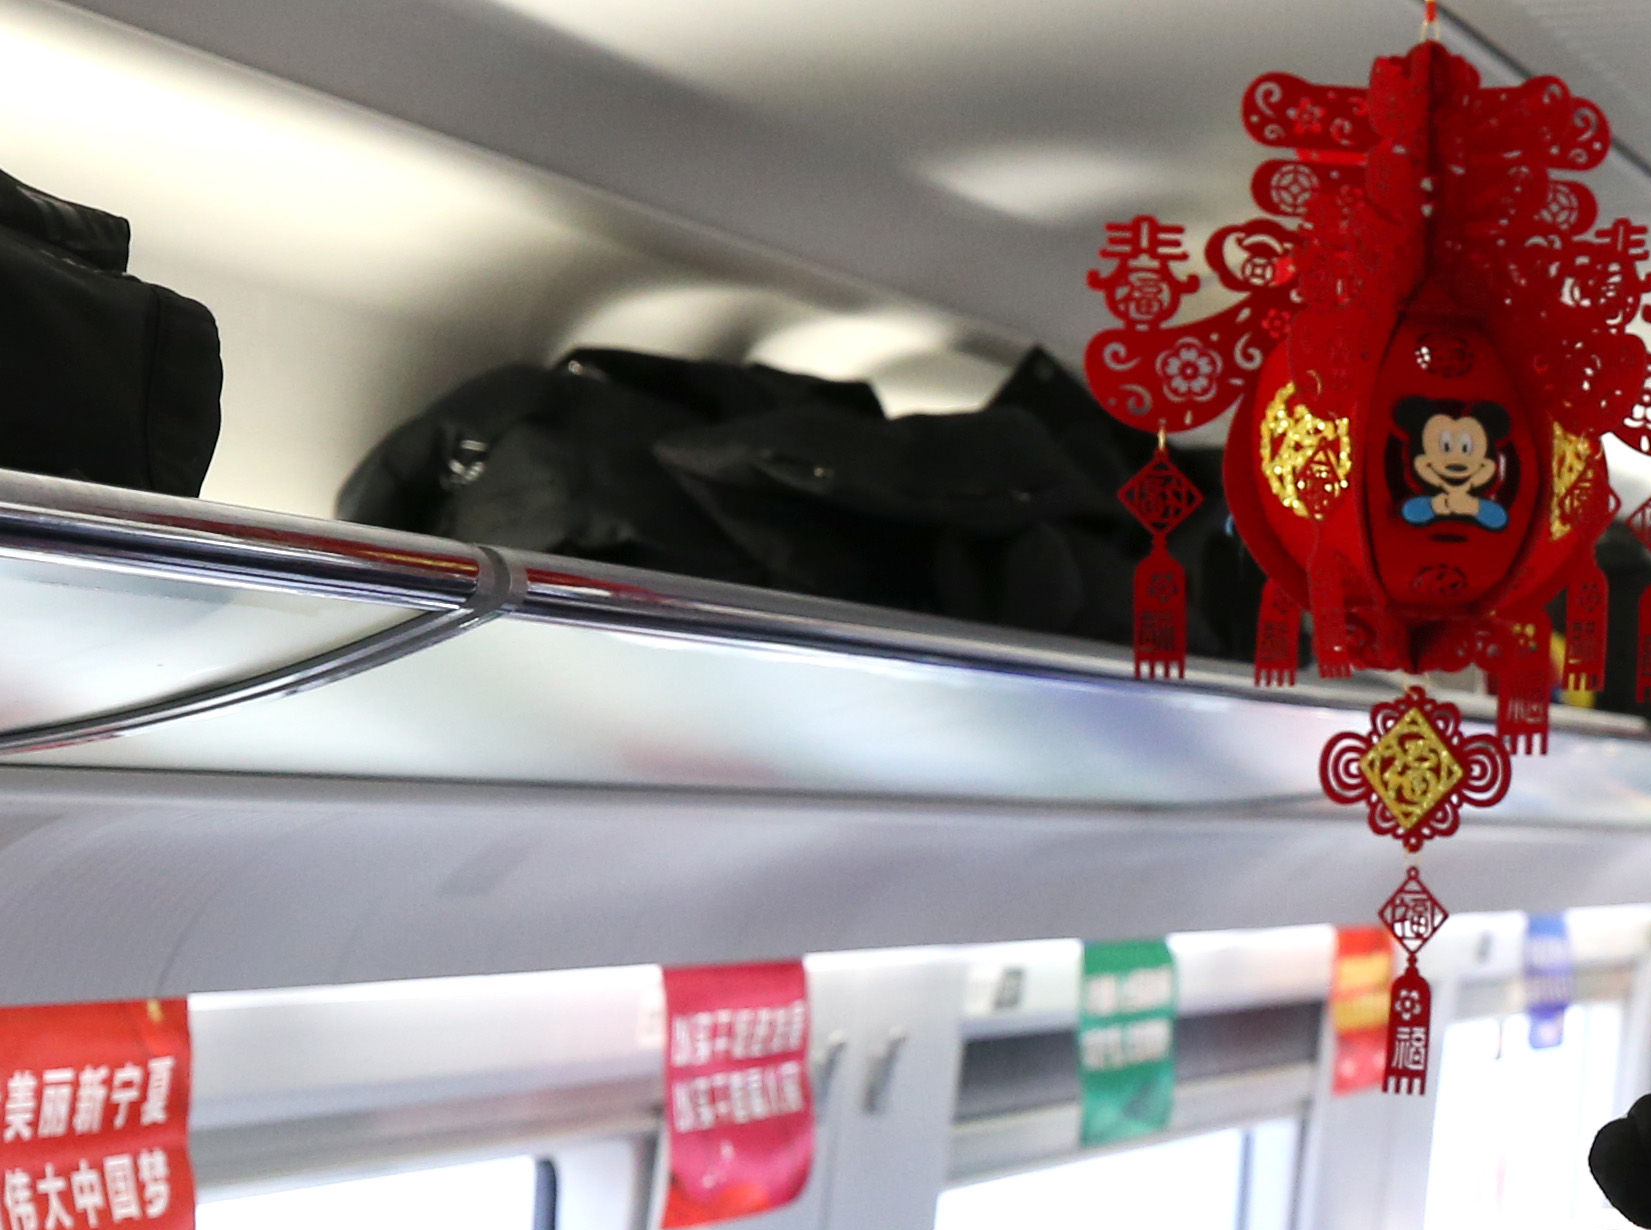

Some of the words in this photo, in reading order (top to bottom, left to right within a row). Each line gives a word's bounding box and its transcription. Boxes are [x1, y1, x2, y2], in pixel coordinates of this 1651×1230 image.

[1391, 1026, 1426, 1071] 福
[0, 1055, 176, 1143] 美丽新宁夏
